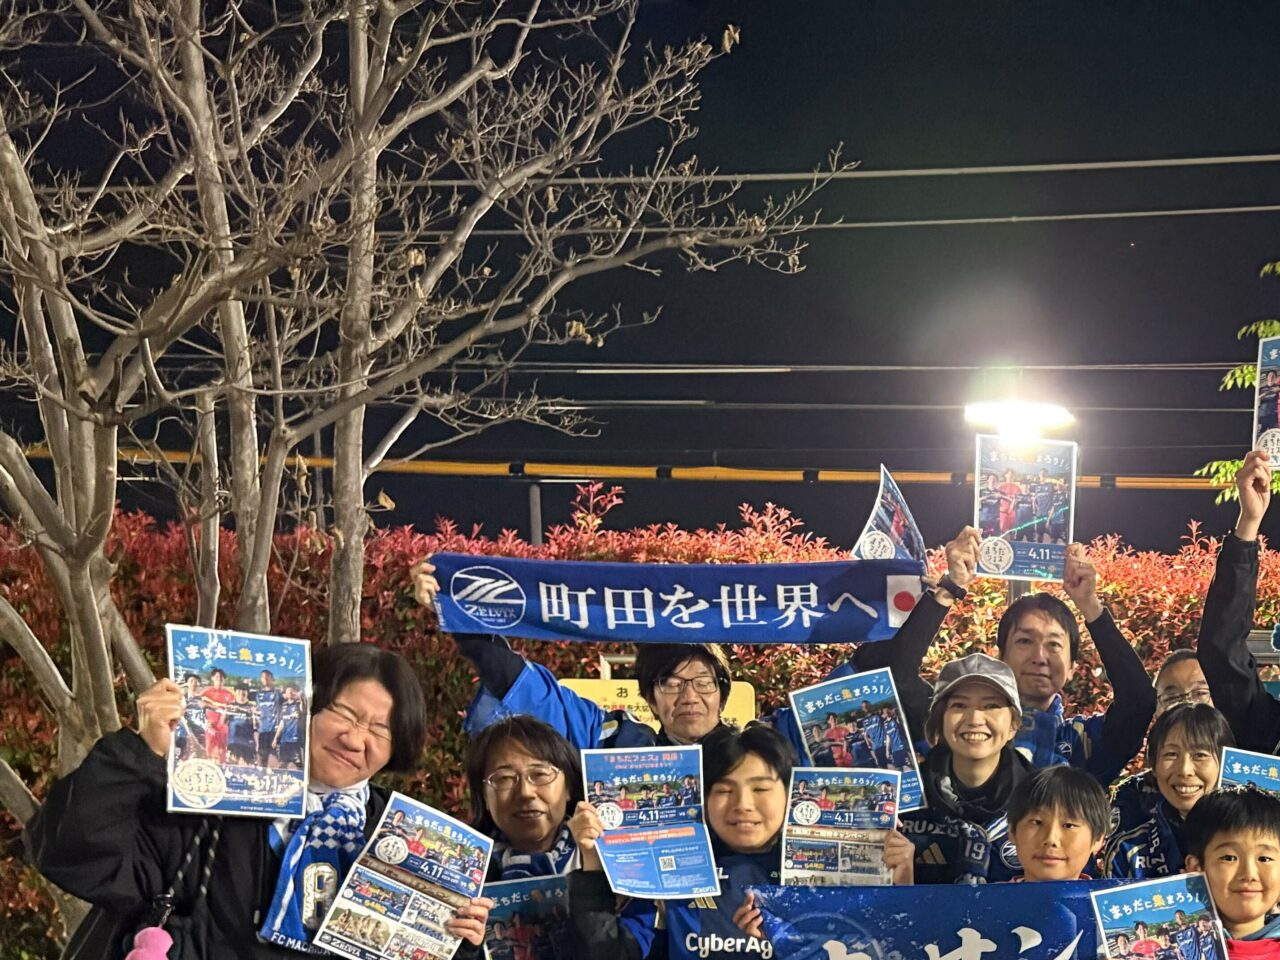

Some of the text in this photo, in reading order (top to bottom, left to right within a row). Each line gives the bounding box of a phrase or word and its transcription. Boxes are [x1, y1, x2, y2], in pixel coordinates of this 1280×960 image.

[1028, 548, 1050, 561] 4.11
[539, 580, 880, 631] 町田を世界へ
[639, 810, 660, 822] 4.11
[835, 812, 854, 822] 4.11
[420, 861, 443, 880] 4.11
[271, 931, 286, 945] FC
[685, 932, 773, 960] CyberAg
